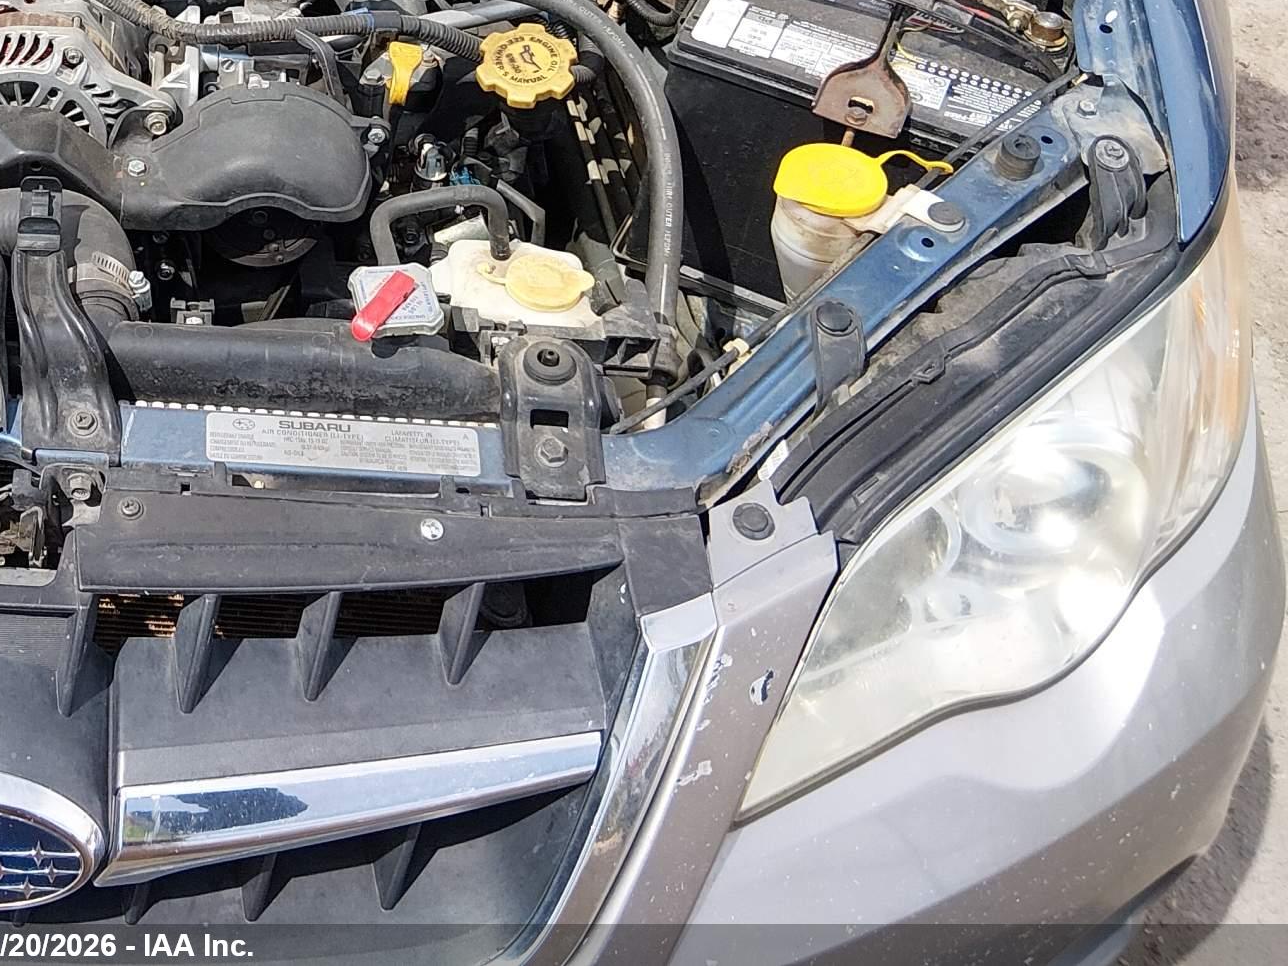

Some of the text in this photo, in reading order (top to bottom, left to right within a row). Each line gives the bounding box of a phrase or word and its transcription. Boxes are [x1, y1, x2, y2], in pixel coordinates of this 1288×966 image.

[529, 36, 559, 72] ENGINE OIL
[510, 73, 548, 85] MANUAL
[278, 420, 351, 433] SUBARU
[261, 428, 275, 436] AIR
[276, 429, 328, 440] CONDITIONER
